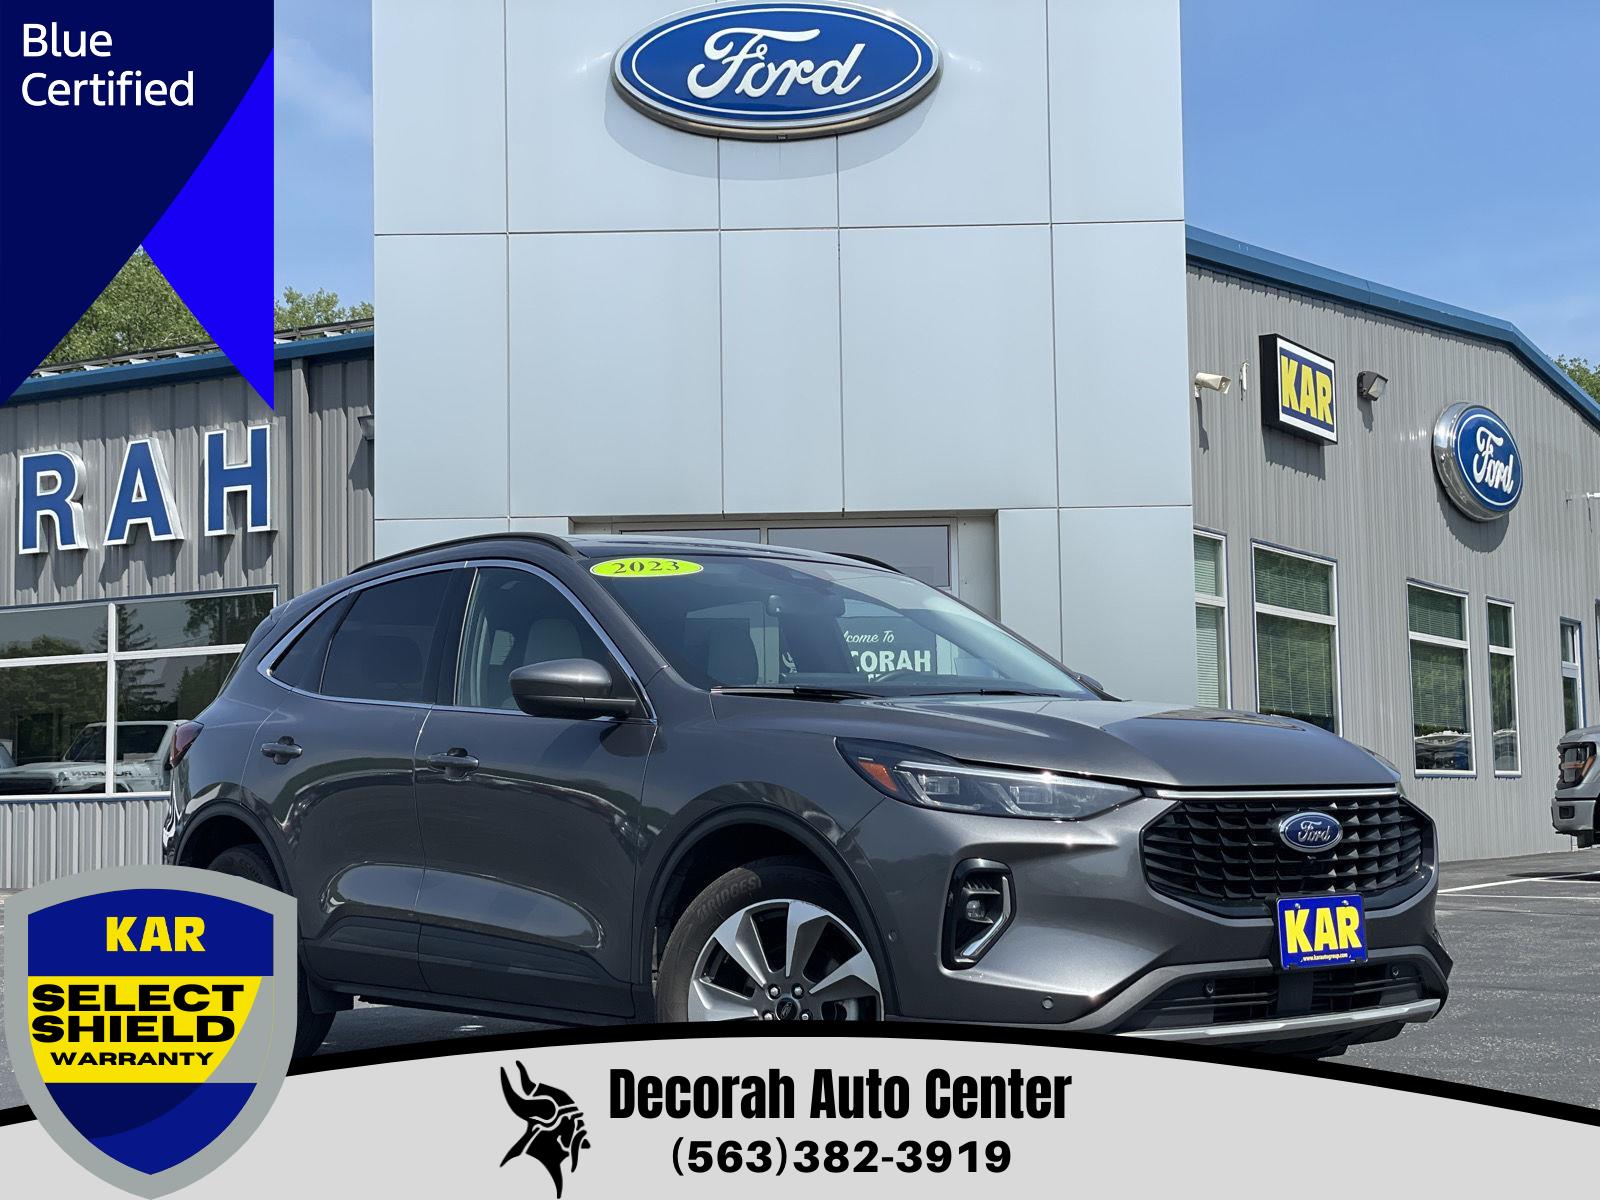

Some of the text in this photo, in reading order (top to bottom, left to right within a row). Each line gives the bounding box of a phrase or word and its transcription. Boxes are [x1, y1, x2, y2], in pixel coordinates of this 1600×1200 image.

[687, 27, 865, 99] Ford
[1280, 355, 1333, 424] KAR
[1472, 426, 1514, 494] Ford
[18, 424, 273, 555] RAH
[611, 560, 680, 574] 2023
[883, 630, 895, 643] To
[1297, 820, 1331, 842] Ford
[1284, 906, 1363, 954] KAR
